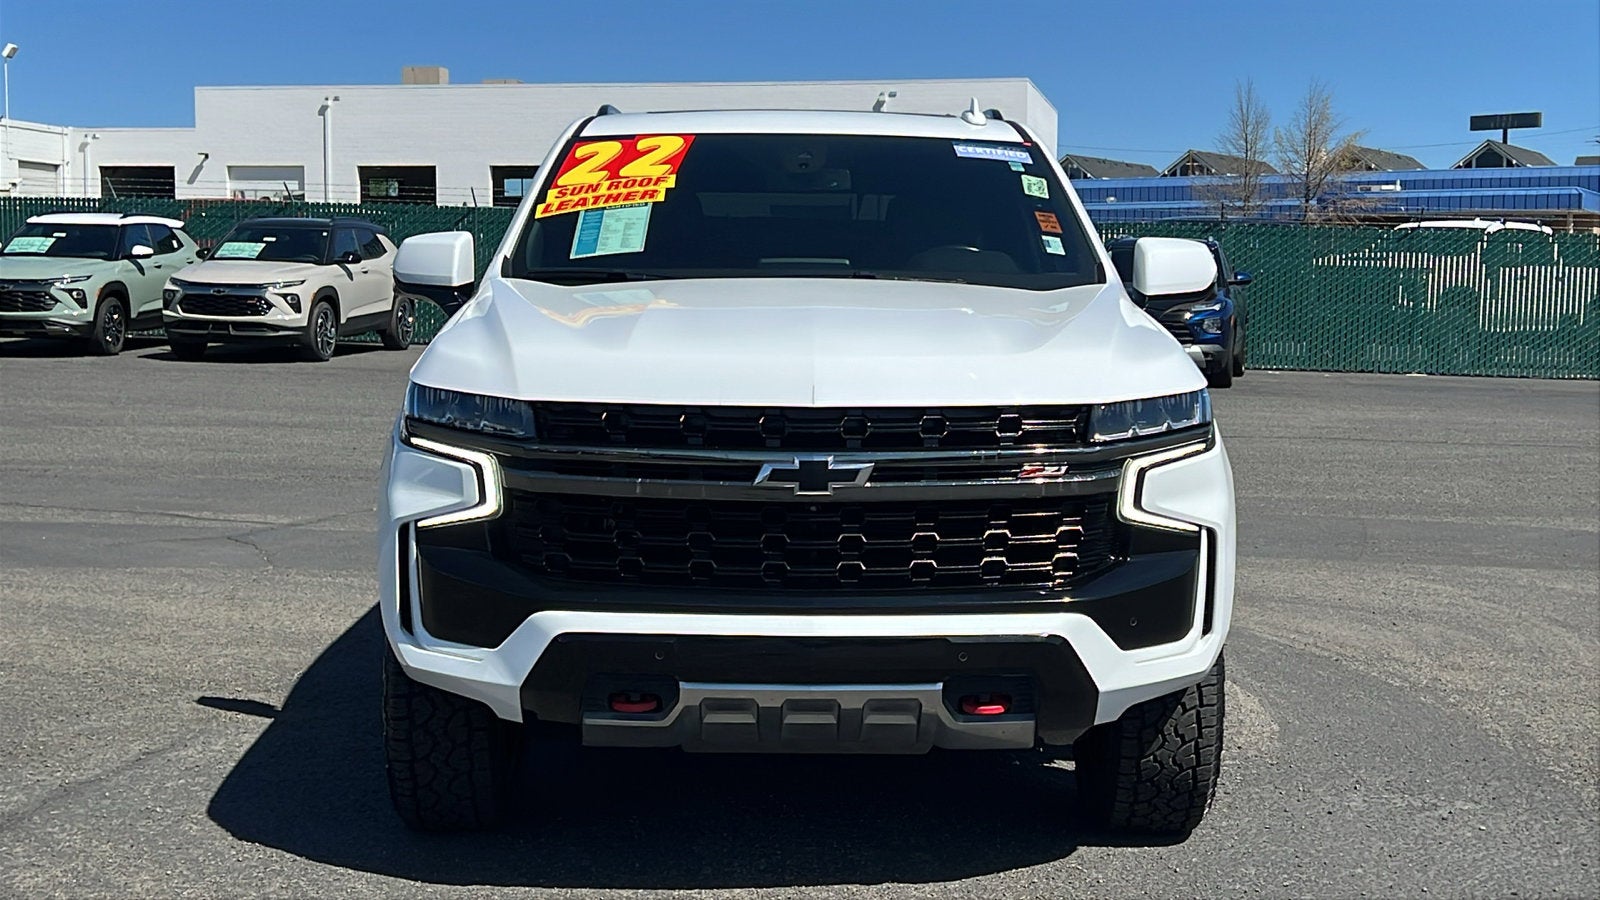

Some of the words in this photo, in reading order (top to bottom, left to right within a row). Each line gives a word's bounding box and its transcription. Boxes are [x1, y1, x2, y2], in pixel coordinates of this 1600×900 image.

[557, 135, 687, 187] 22
[957, 145, 1028, 159] CERTIFIED
[555, 183, 602, 199] SUN
[606, 176, 669, 191] ROOF
[541, 189, 659, 214] LEATHER
